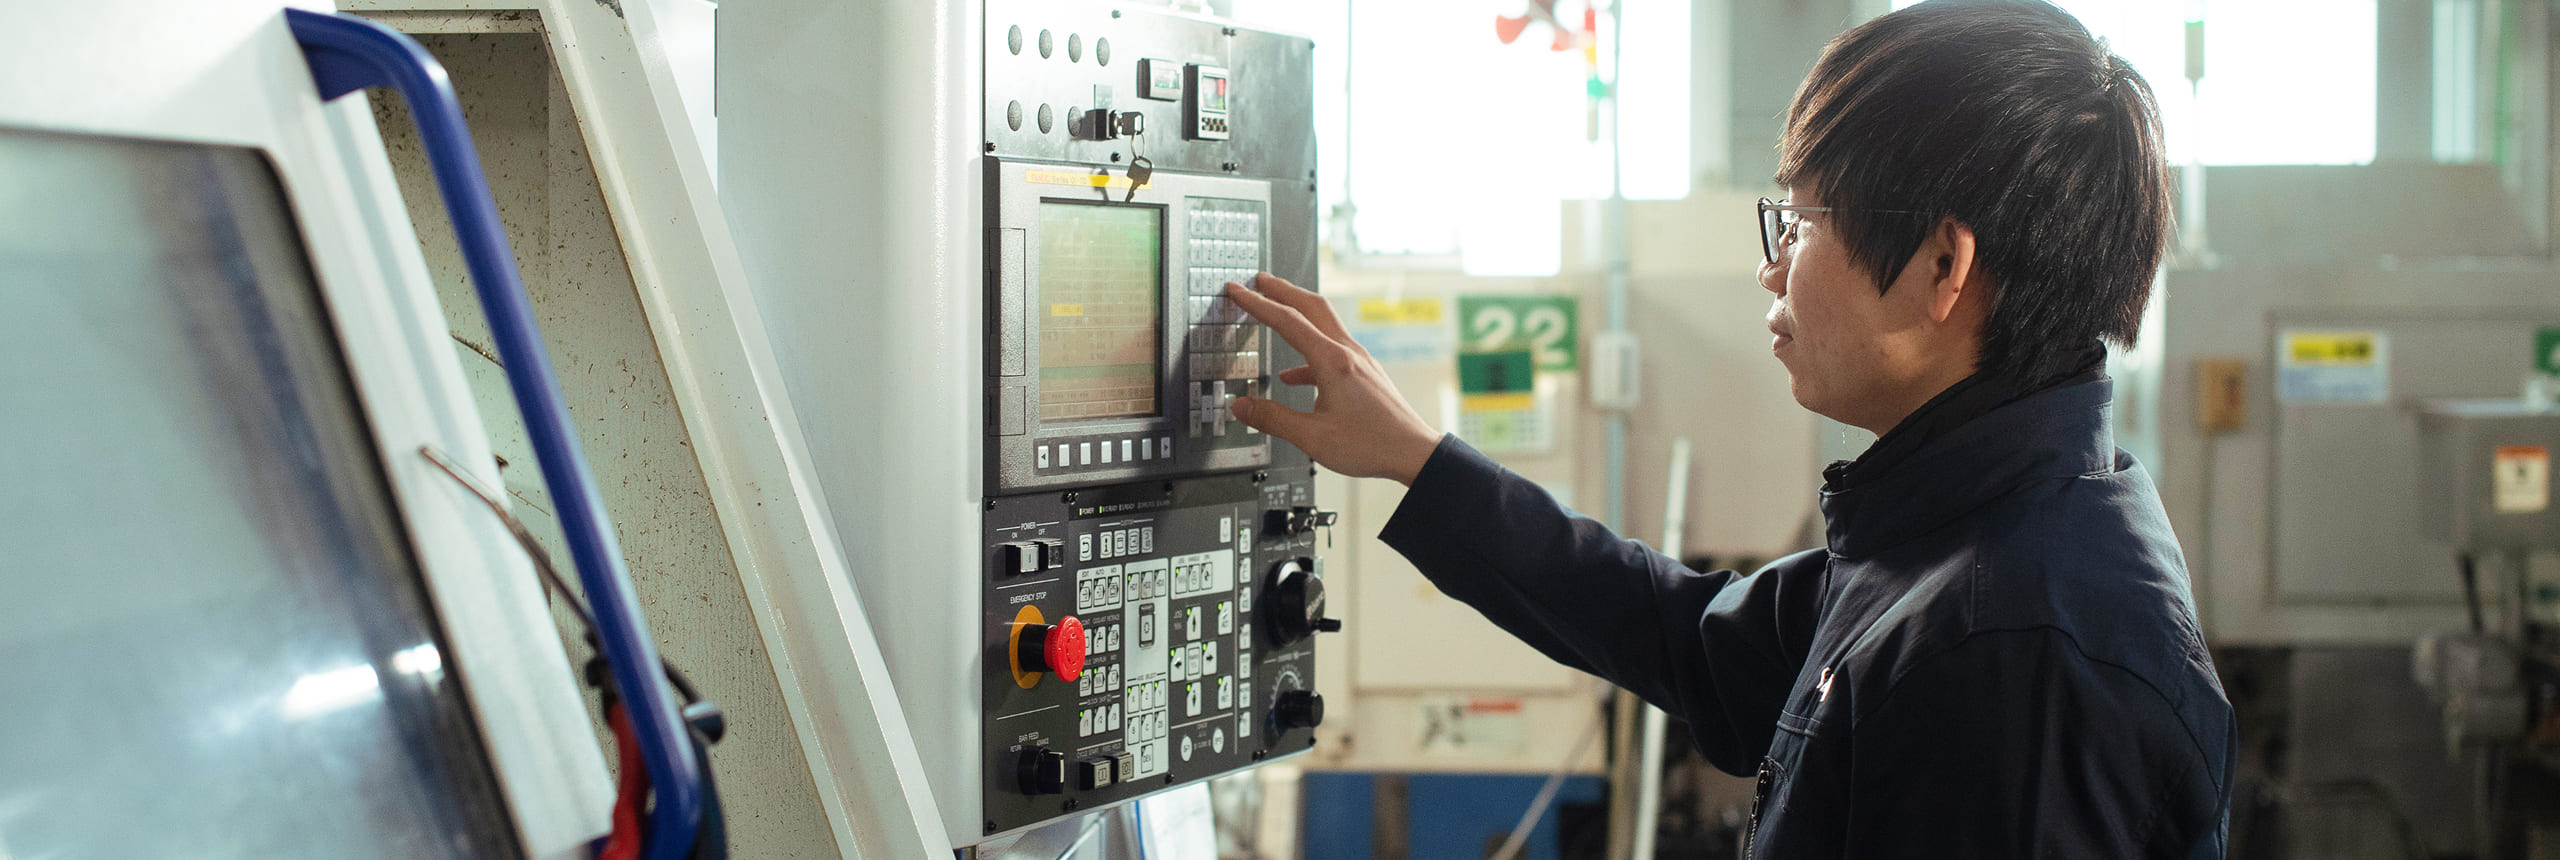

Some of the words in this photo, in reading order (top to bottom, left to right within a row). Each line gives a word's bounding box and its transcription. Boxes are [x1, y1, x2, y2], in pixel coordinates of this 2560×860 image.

[1021, 521, 1036, 530] POWER
[1038, 528, 1046, 536] OFF
[1010, 594, 1035, 604] EMERGENCY
[1036, 592, 1047, 600] STOP
[1018, 734, 1028, 742] BAR
[1029, 731, 1039, 741] FEED
